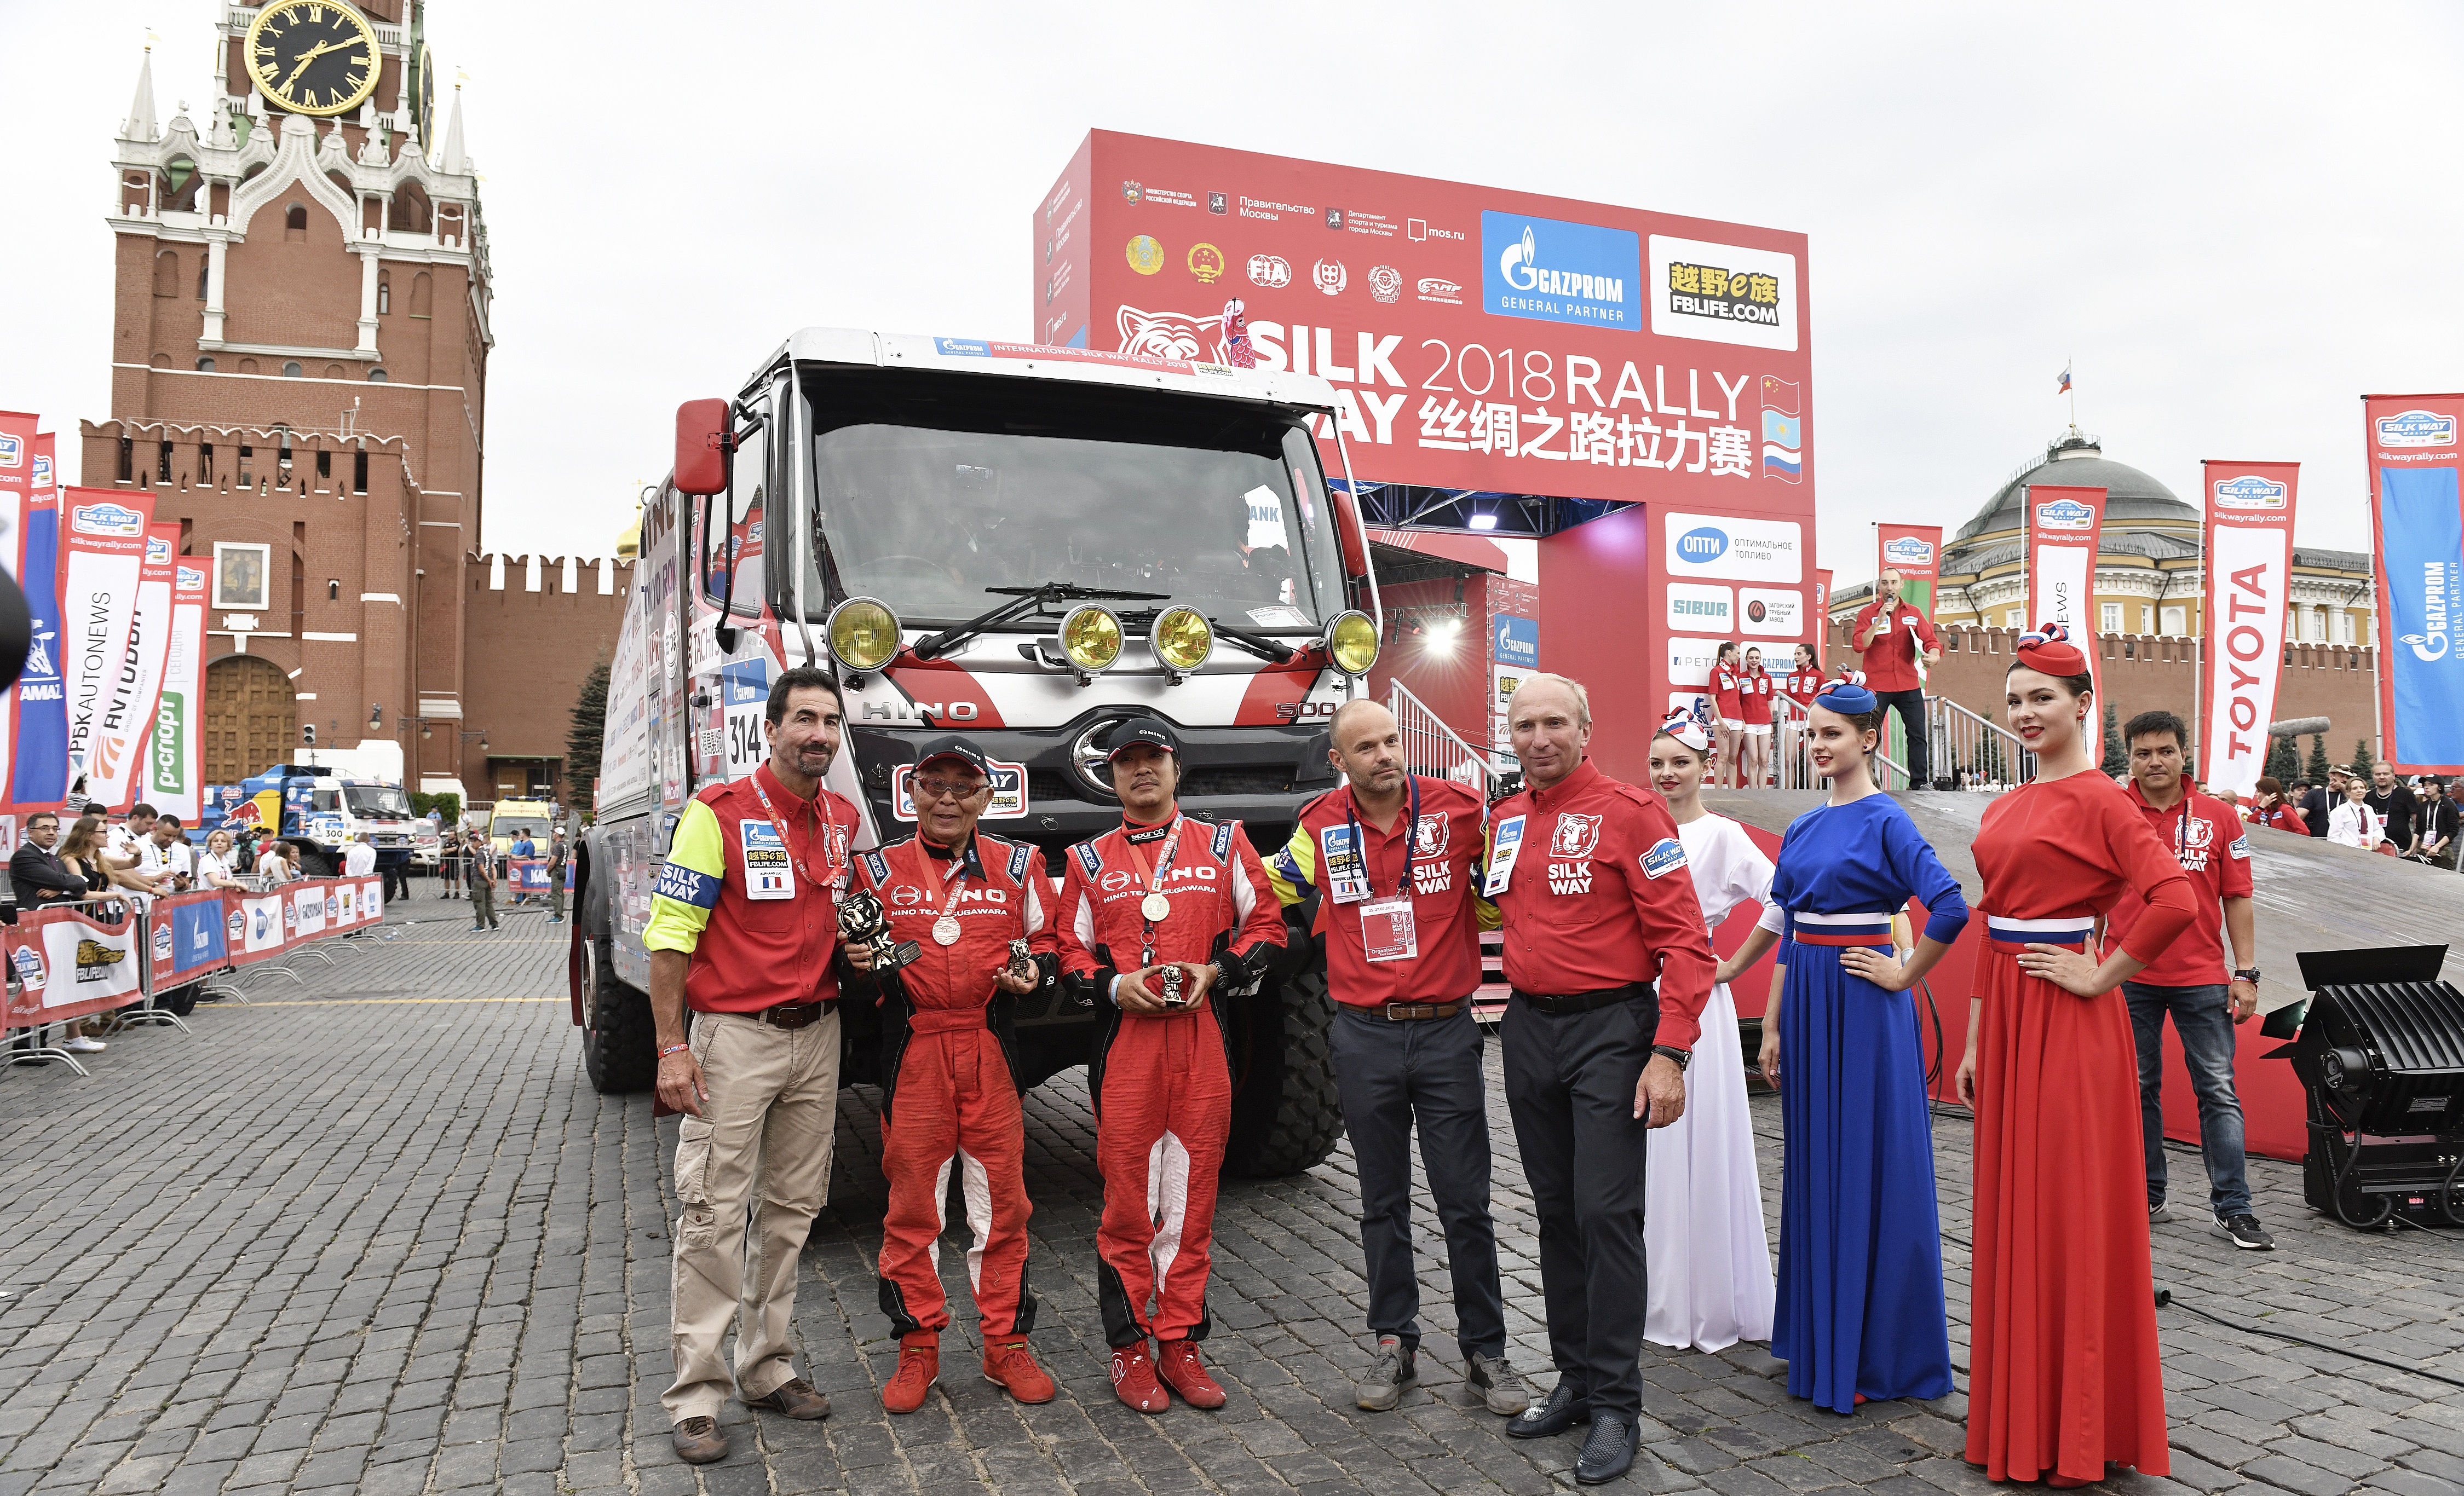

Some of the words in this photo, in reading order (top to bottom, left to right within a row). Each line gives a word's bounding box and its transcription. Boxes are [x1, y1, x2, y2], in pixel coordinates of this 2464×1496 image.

[1145, 188, 1177, 198] МИНИСТЕРСТВО
[1145, 195, 1172, 204] РОССИЙСКОЙ
[1173, 198, 1197, 207] ФЕДЕРАЦИИ
[1240, 196, 1315, 215] Правительство
[1240, 208, 1279, 221] Москвы
[1348, 210, 1386, 221] Департамент
[1349, 226, 1368, 234] города
[1370, 228, 1392, 236] Москвы
[1429, 228, 1465, 240] mos.ru
[1423, 282, 1463, 292] CAMF
[1538, 272, 1623, 303] GAZPROM
[1501, 296, 1560, 315] GENERAL
[1567, 303, 1624, 322] PARTNER
[1672, 294, 1777, 325] FBLIFE.COM
[993, 344, 1080, 357] INTERNATIONAL
[1081, 350, 1104, 360] SILK
[1107, 353, 1130, 362] WAY
[1132, 356, 1164, 367] RALLY
[1165, 360, 1188, 369] 2018
[1247, 320, 1408, 388] SILK
[1421, 338, 1557, 402] 2018
[1567, 353, 1751, 421] RALLY
[2384, 423, 2416, 431] SILK
[2418, 422, 2448, 431] WAY
[1418, 394, 1752, 480] 丝绸之路拉力赛
[2378, 452, 2458, 463] silkwayrally.com
[2252, 487, 2279, 495] WAY
[80, 512, 109, 521] SILK
[110, 515, 135, 523] WAY
[2214, 511, 2287, 523] silkwayrally.com
[70, 536, 142, 550] silkwayrally.com
[1684, 535, 1720, 554] ОПТИ
[1735, 538, 1793, 550] ОПТИМАЛЬНОЕ
[2037, 532, 2091, 542] silkwayrally.com
[1735, 550, 1771, 561] ТОПЛИВО
[2450, 561, 2459, 609] PARTNER
[2427, 562, 2445, 632] GAZPROM
[1673, 599, 1728, 616] SIBUR
[2455, 610, 2464, 660] GENERAL
[1510, 640, 1534, 655] GAZPROM
[1500, 652, 1517, 661] GENERAL
[1763, 658, 1795, 669] GAZPROM
[2227, 563, 2267, 761] TOYOTA
[20, 683, 62, 701] AMAZ
[124, 713, 133, 732] GROUP
[131, 702, 137, 712] OF
[135, 668, 147, 703] COMPANIES
[862, 701, 978, 721] HINO
[1275, 702, 1337, 719] 500
[729, 713, 762, 765] 314
[1147, 731, 1166, 741] HINO
[962, 747, 982, 761] HINO
[990, 774, 1014, 788] AY
[1131, 827, 1165, 841] sparco
[1216, 825, 1228, 854] sparco
[748, 851, 787, 862] 越野e族
[870, 852, 885, 877] sparco
[968, 849, 976, 863] sparco
[1012, 847, 1024, 875] sparco
[1081, 843, 1098, 869] sparco
[1647, 849, 1671, 868] SILK
[1668, 845, 1682, 859] WAY
[1663, 855, 1679, 864] RALLY
[662, 865, 703, 889] SILK
[1413, 859, 1452, 882] SILK
[1548, 861, 1593, 880] SILK
[659, 879, 701, 902] WAY
[1415, 874, 1452, 896] WAY
[1549, 877, 1593, 896] WAY
[1103, 891, 1128, 904] HINO
[1161, 885, 1217, 896] SUGAWARA
[918, 908, 940, 916] TEA
[952, 908, 1008, 917] SUGAWARA
[1371, 946, 1403, 955] Organisation
[2325, 1140, 2335, 1166] Power
